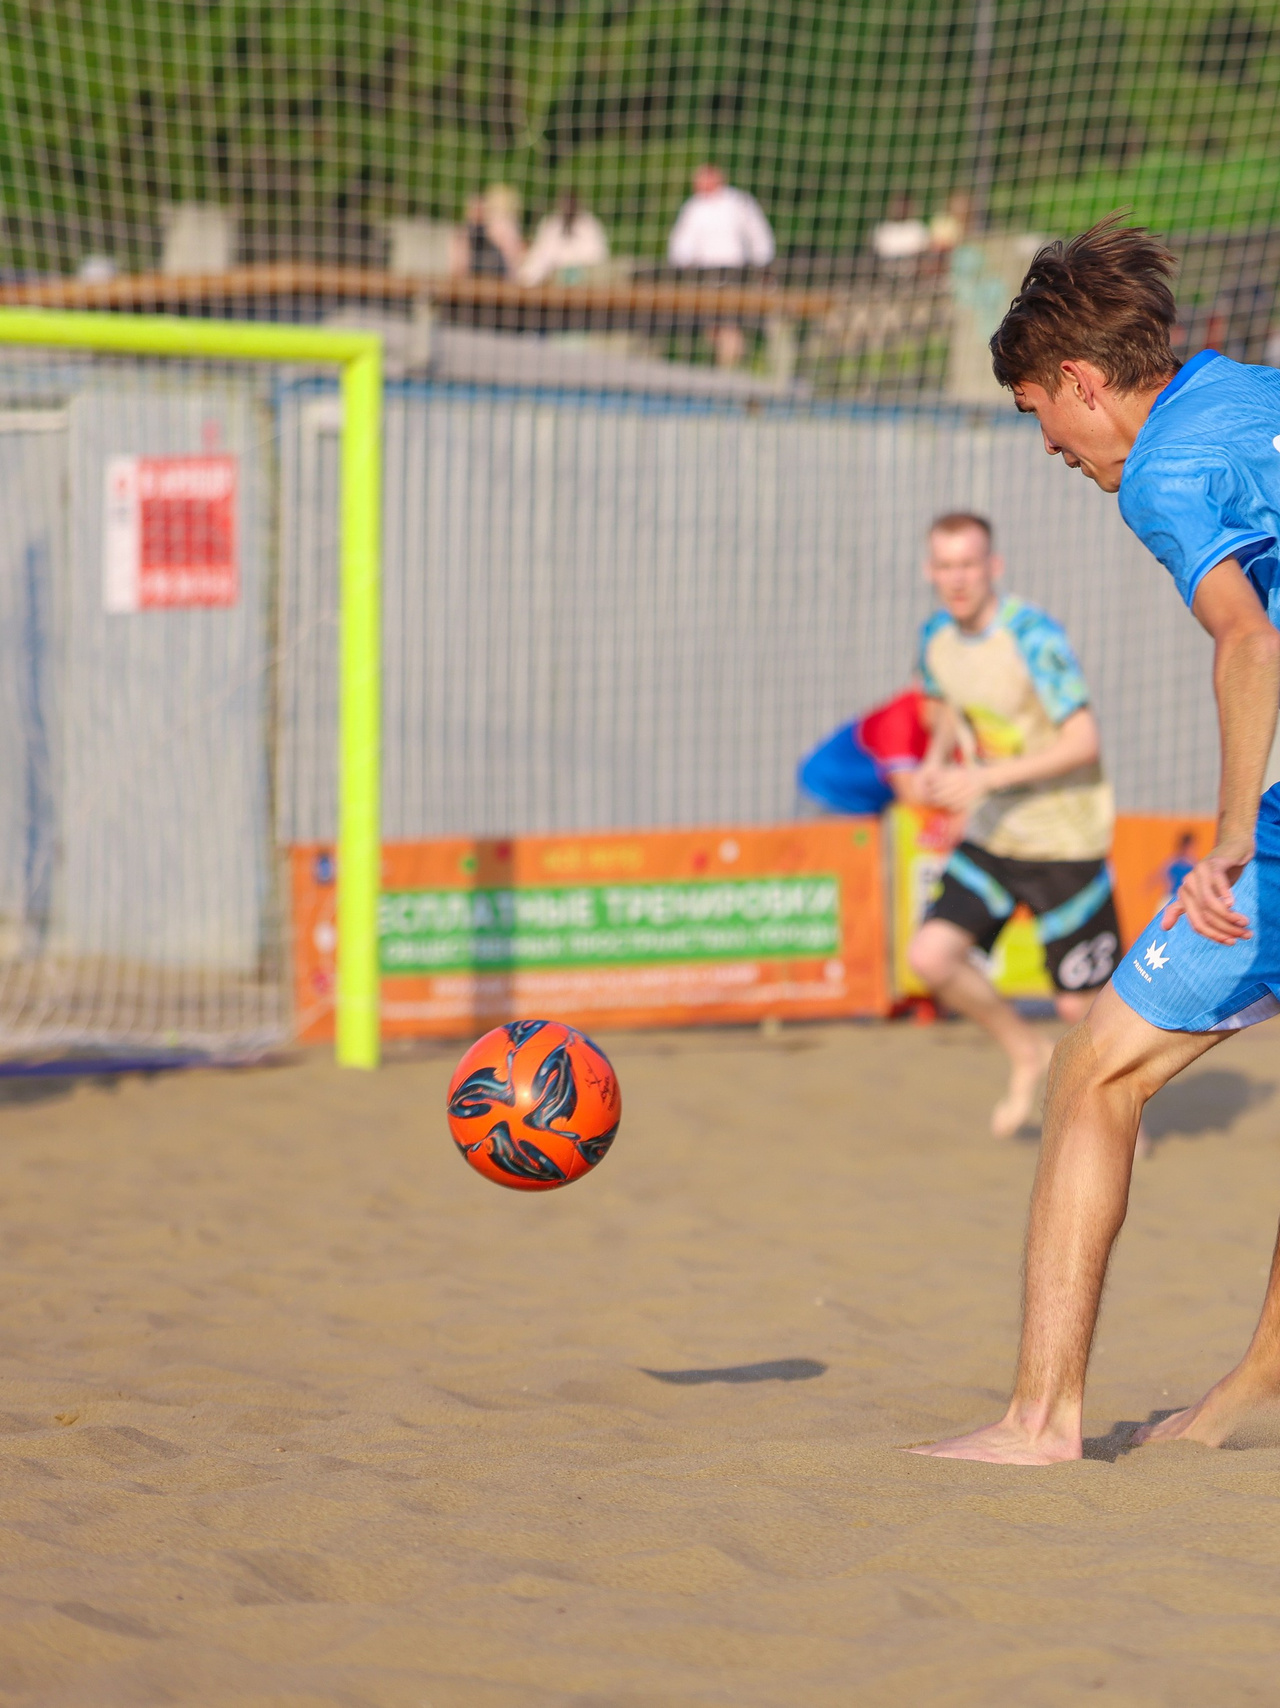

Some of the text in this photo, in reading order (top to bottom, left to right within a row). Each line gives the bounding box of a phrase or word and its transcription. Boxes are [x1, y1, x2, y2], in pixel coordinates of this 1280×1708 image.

[378, 886, 595, 936] ЕСПЛАТНЫЕ
[1058, 931, 1118, 990] 63
[1132, 959, 1153, 984] PRIMERA
